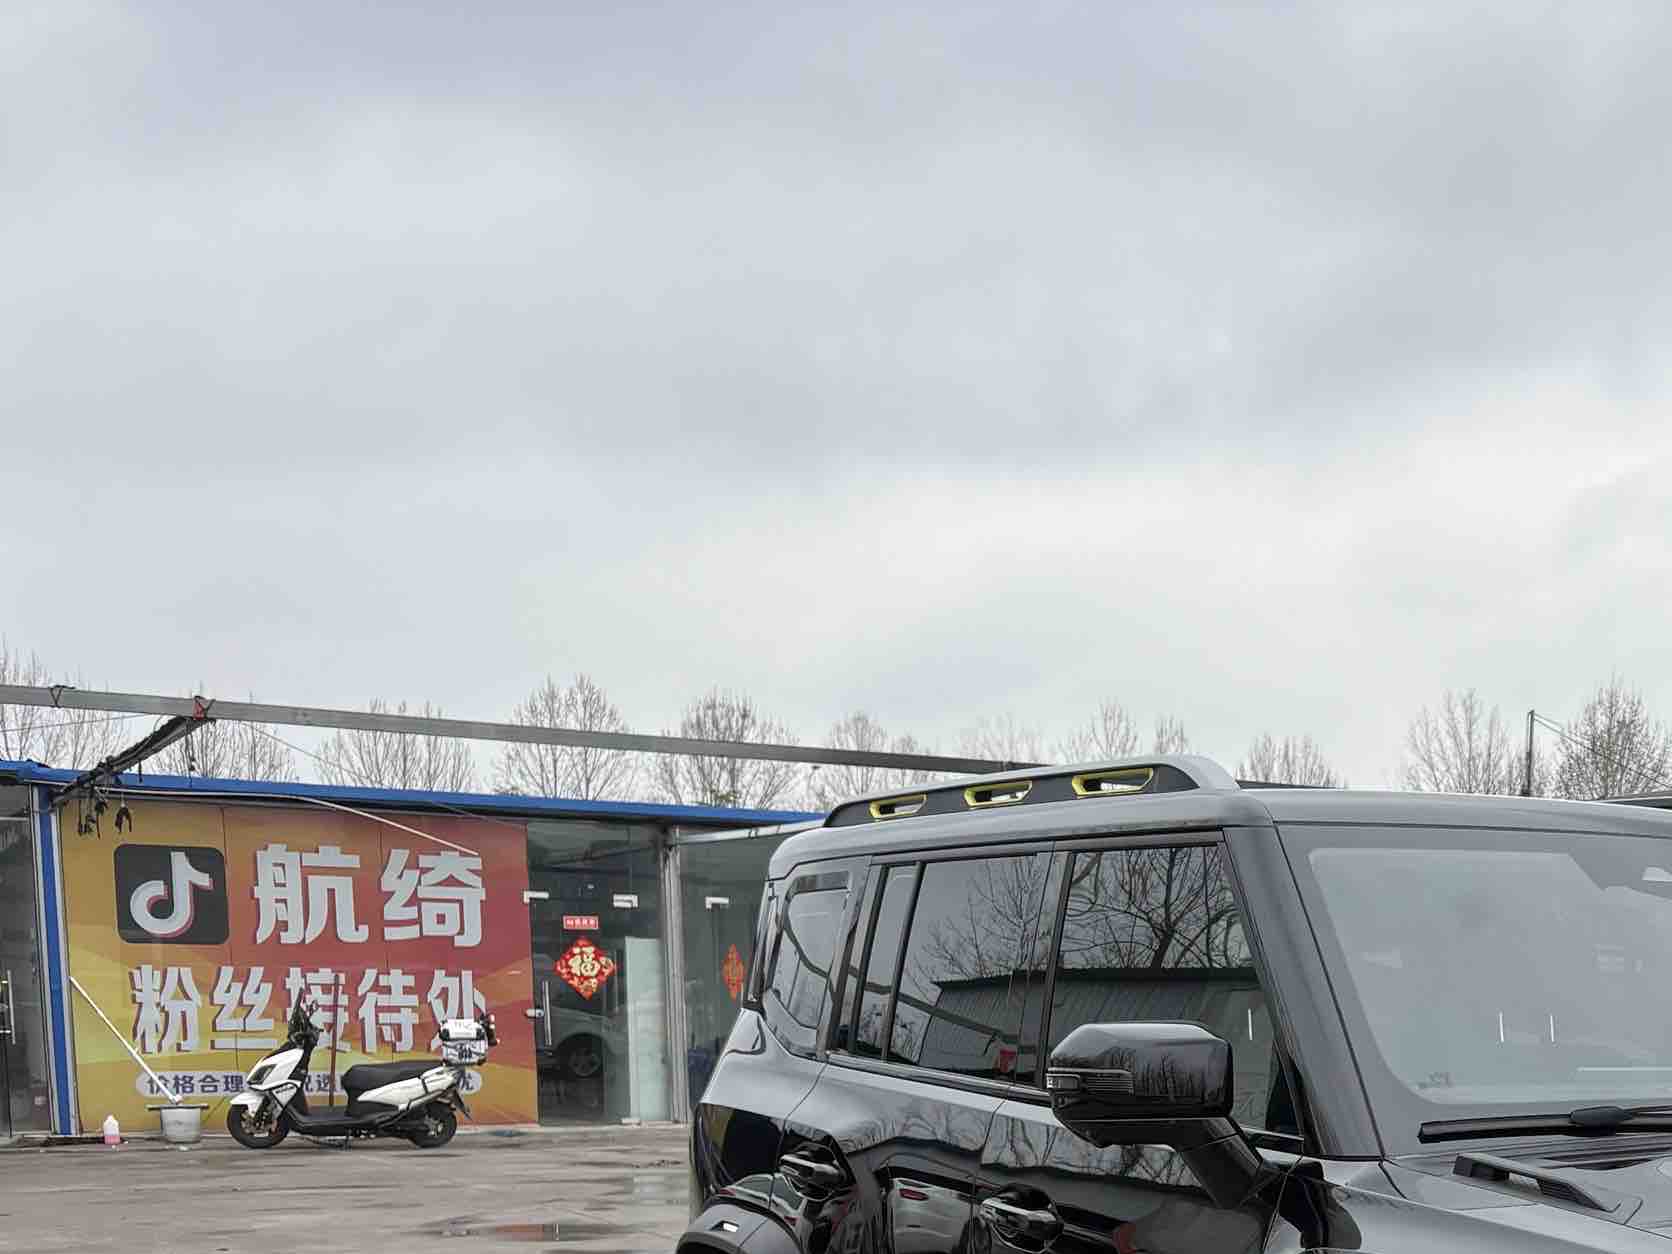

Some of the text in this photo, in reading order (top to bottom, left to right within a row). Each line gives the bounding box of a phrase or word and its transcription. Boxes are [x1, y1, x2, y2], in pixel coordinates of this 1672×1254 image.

[254, 843, 486, 947] 航绮
[128, 964, 487, 1054] 粉丝接待处
